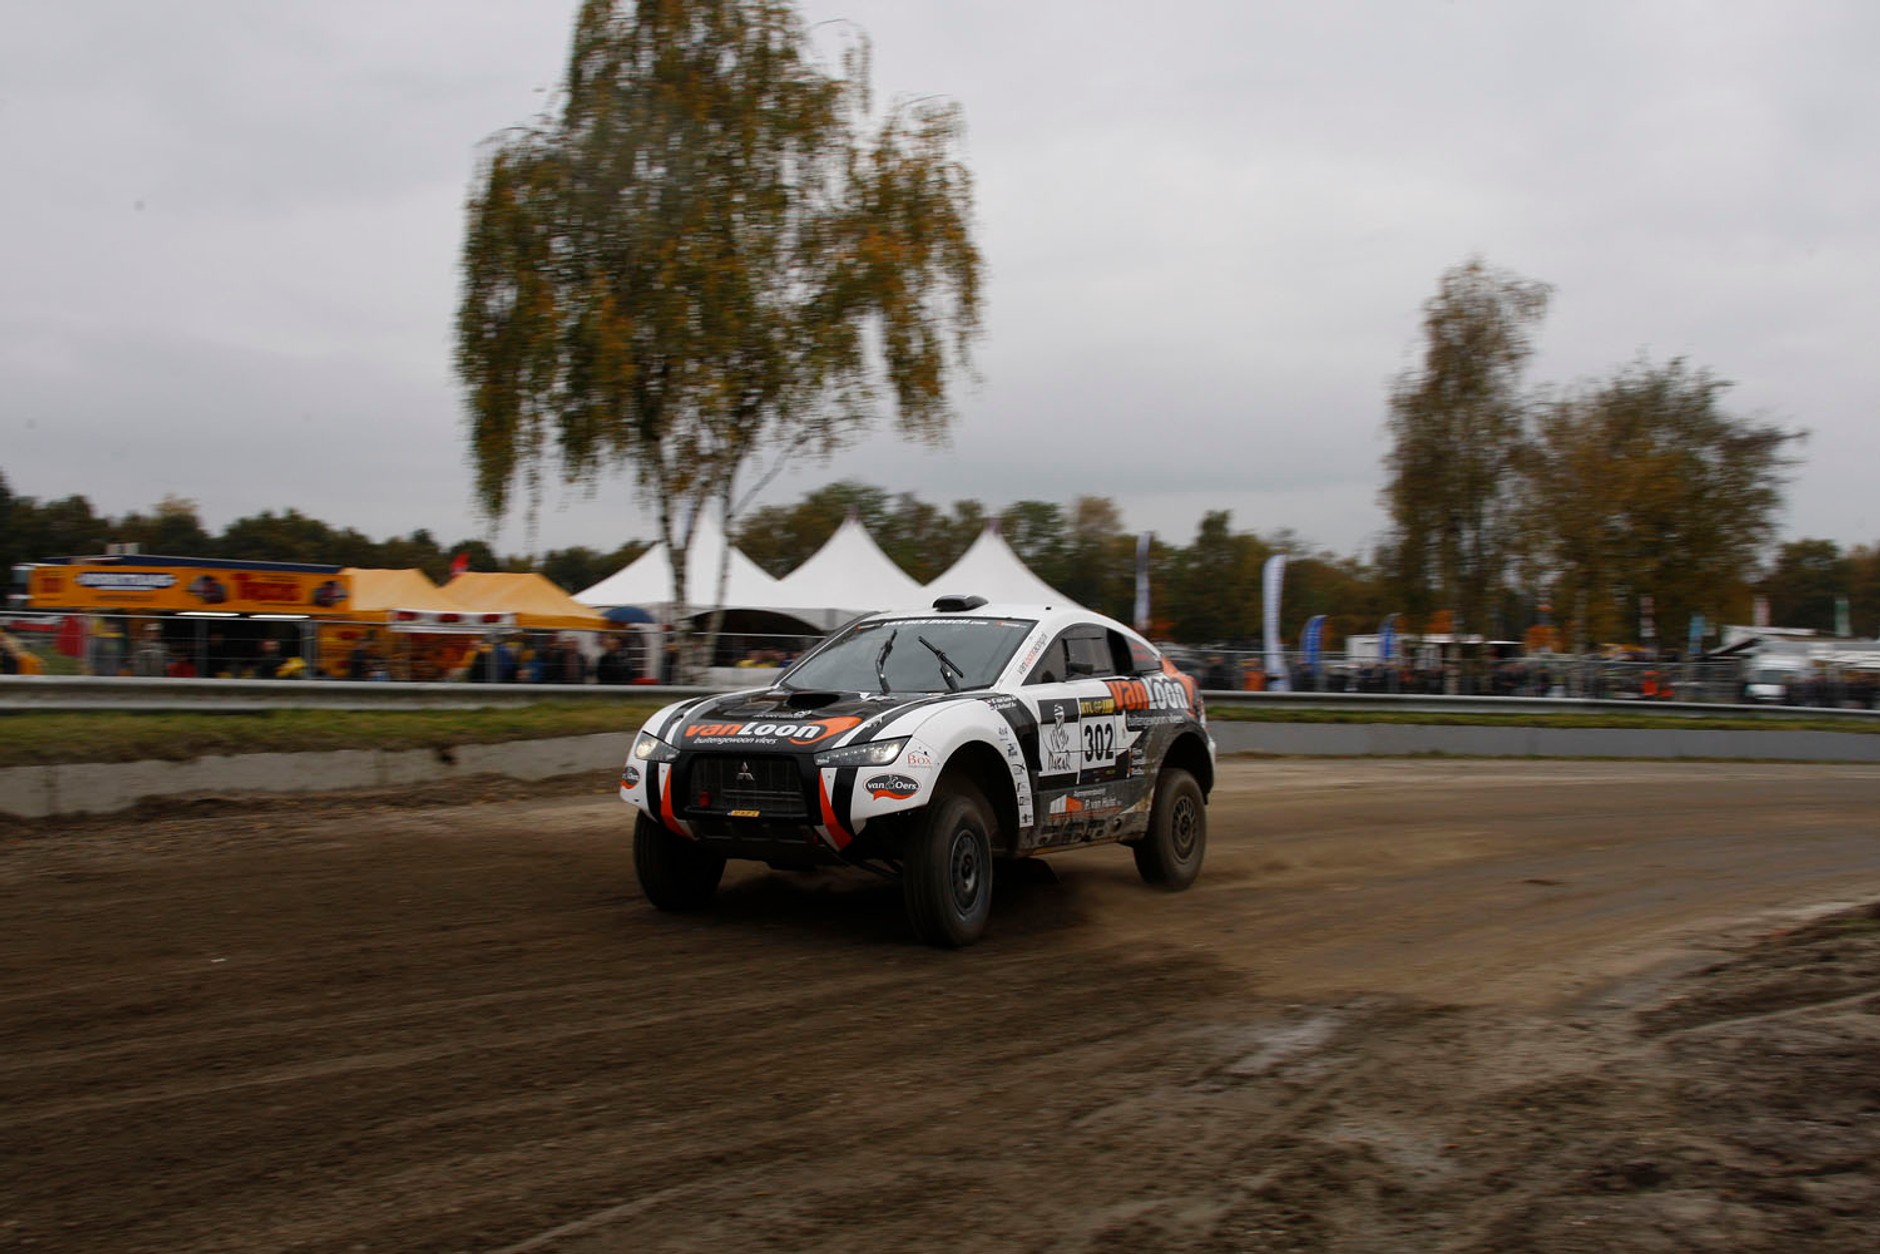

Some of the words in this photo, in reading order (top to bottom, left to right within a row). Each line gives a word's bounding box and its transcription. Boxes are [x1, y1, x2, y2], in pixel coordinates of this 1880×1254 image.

[693, 736, 755, 745] buitengewoon
[755, 737, 778, 745] vlees
[1084, 723, 1114, 762] 302
[894, 781, 919, 790] Oers
